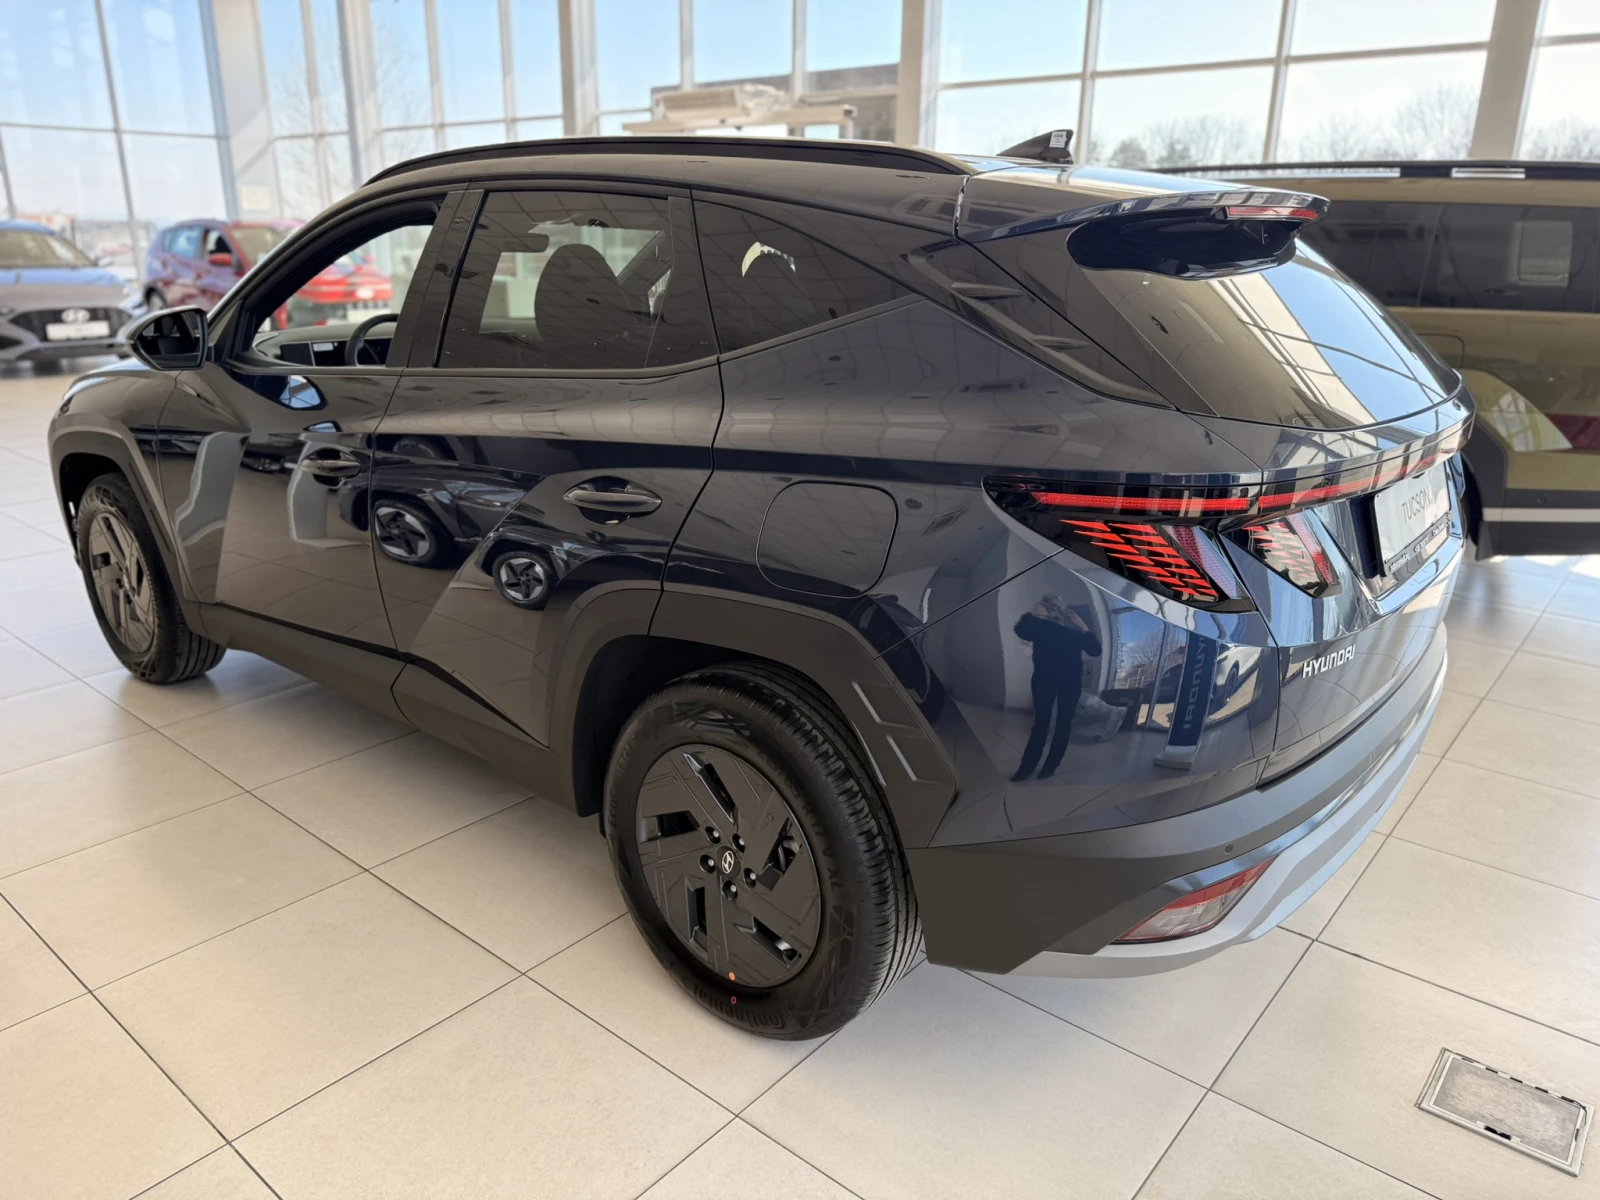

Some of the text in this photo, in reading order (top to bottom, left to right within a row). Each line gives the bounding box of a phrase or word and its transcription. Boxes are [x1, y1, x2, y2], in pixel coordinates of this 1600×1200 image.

[1402, 486, 1432, 523] TUCSON
[1302, 645, 1356, 678] HYUNDAI
[692, 983, 786, 1030] Continental
